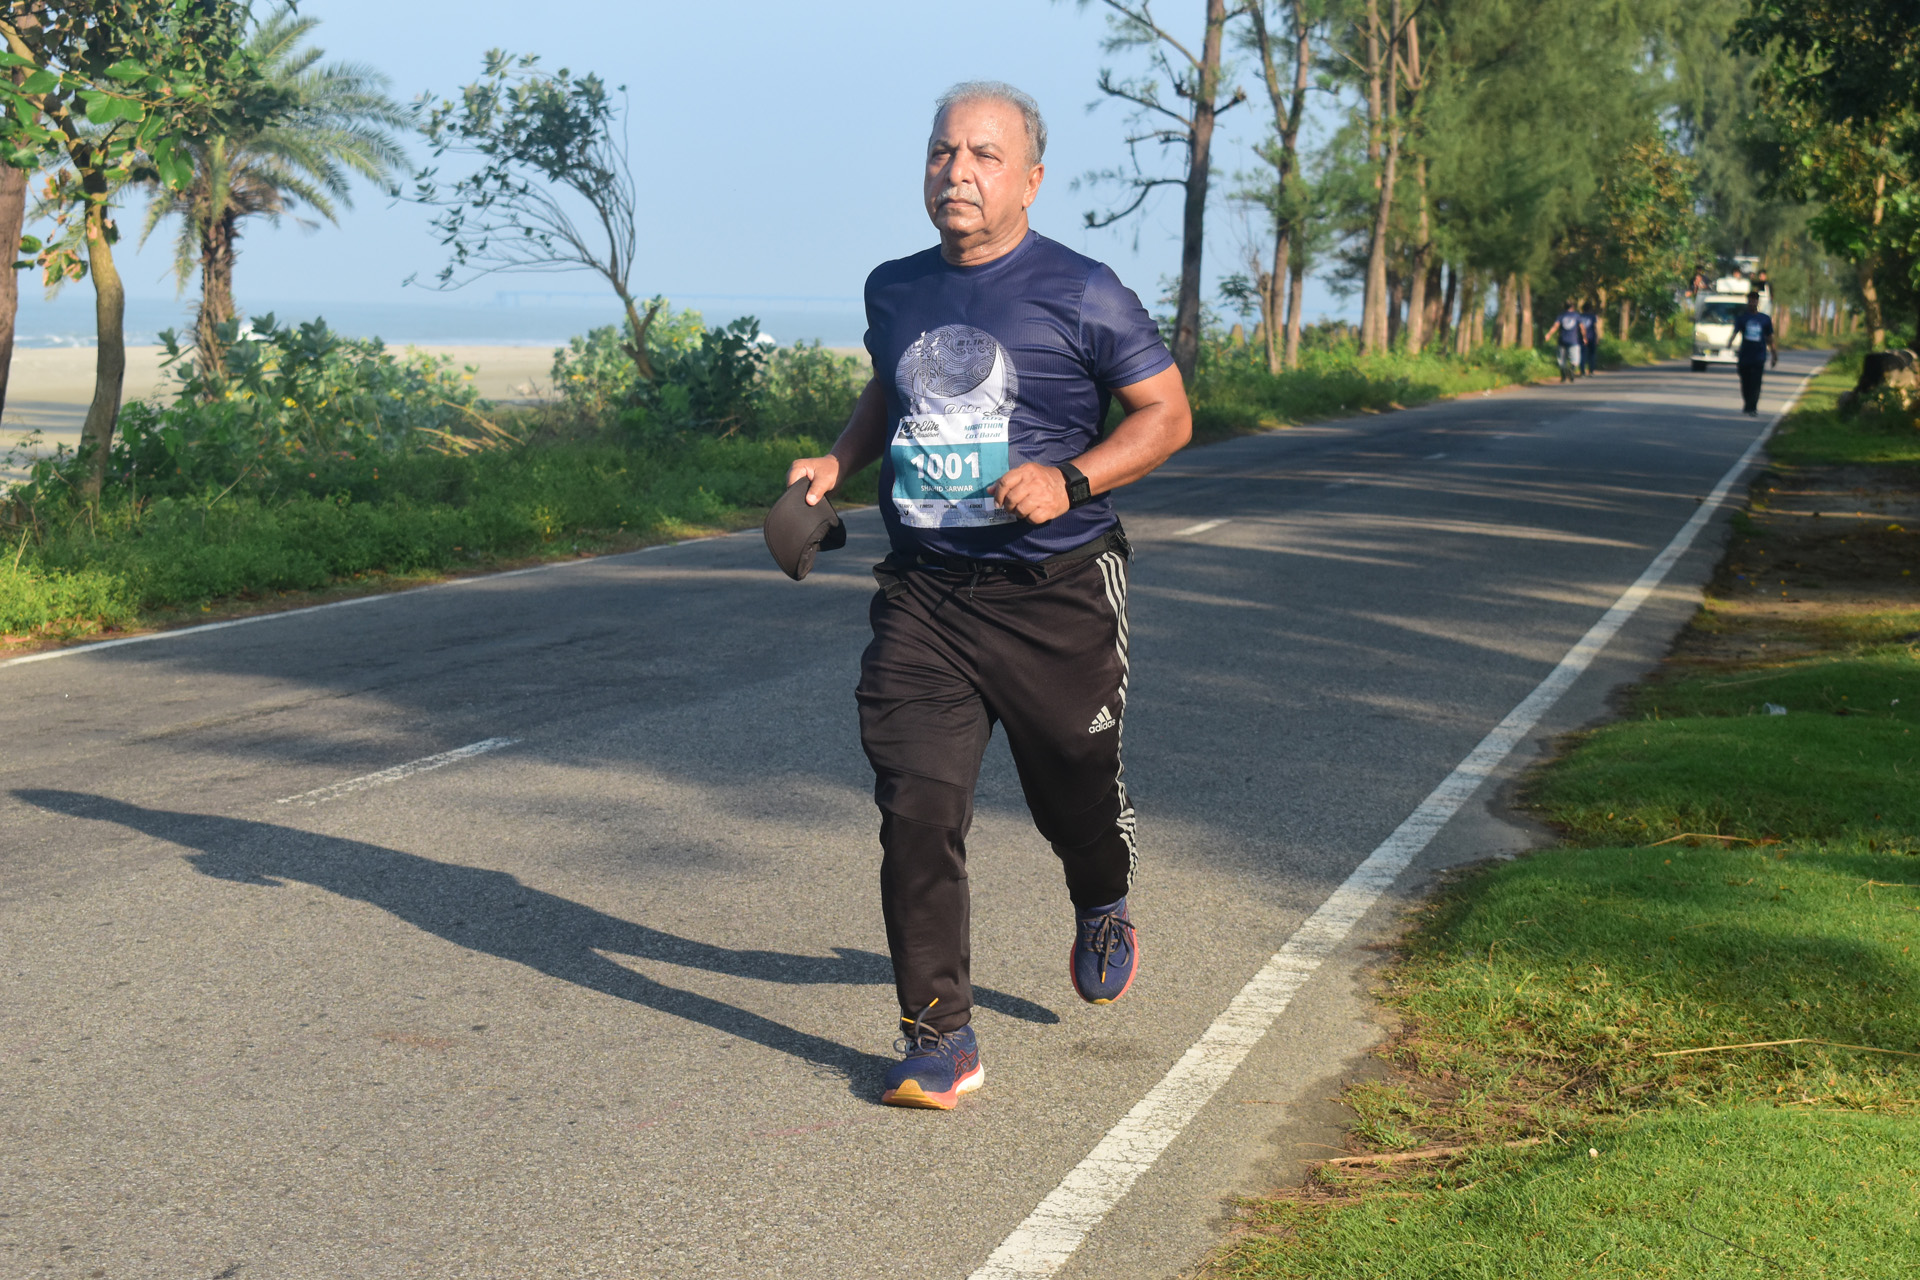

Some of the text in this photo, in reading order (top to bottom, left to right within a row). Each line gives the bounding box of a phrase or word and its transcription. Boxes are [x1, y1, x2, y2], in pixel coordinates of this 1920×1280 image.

[964, 422, 1004, 431] MARATHON
[910, 452, 980, 480] 1001
[1088, 718, 1116, 734] adidas
